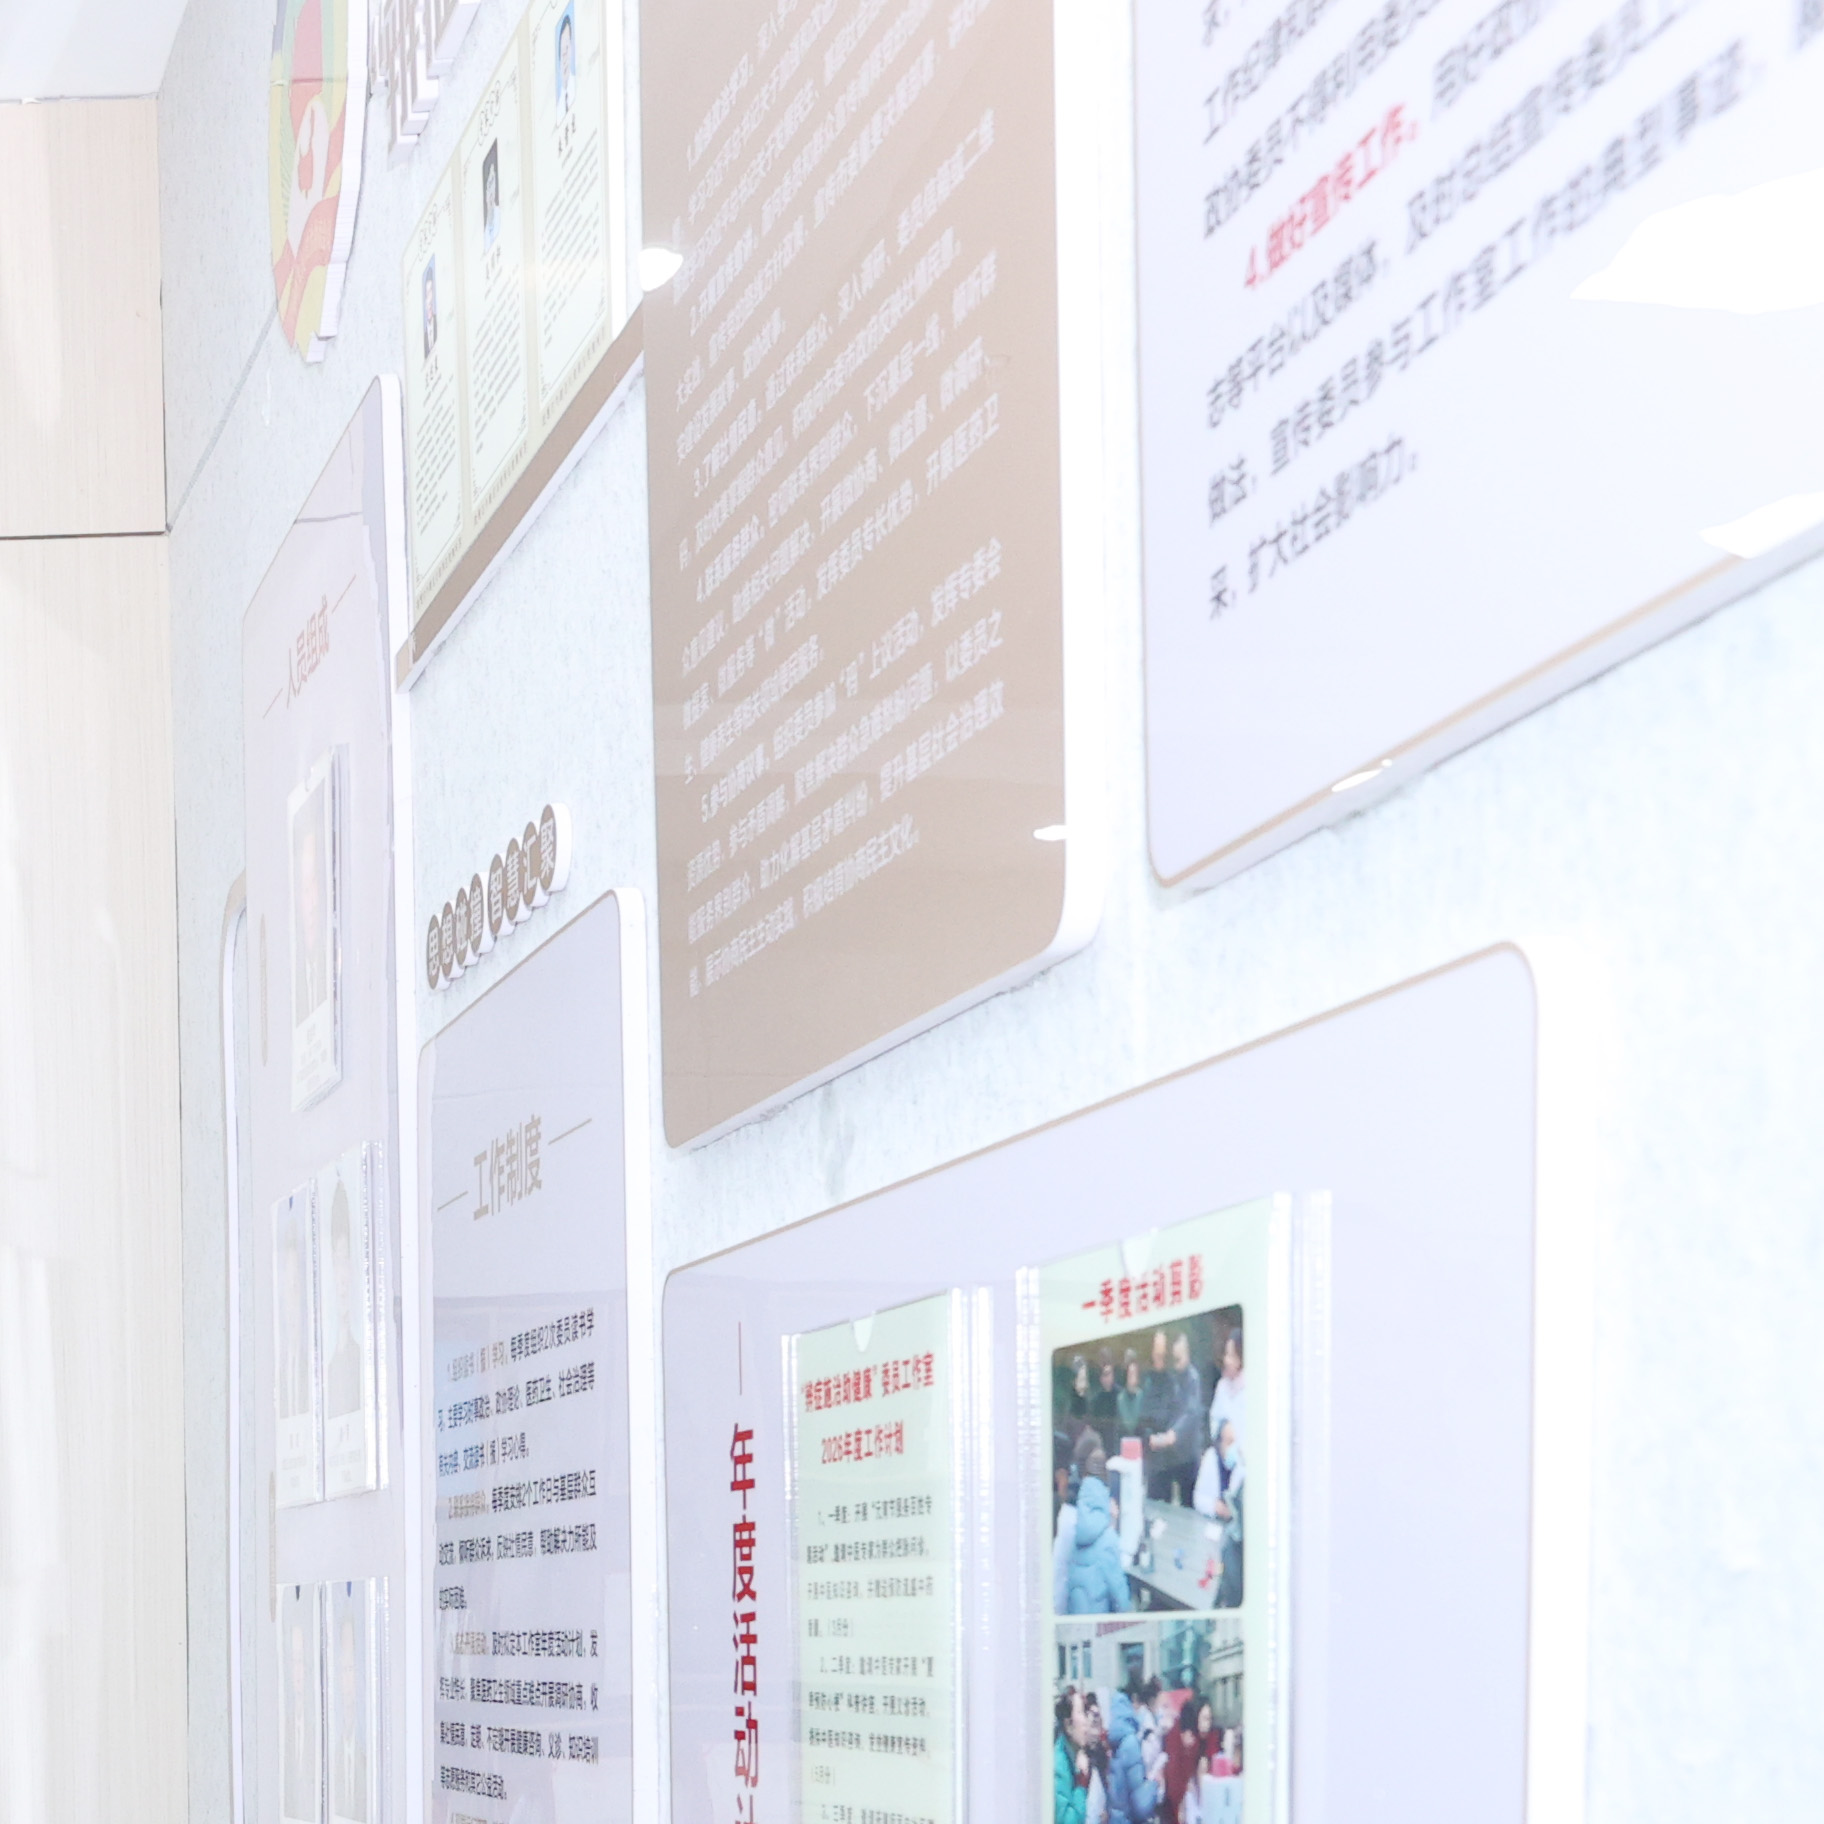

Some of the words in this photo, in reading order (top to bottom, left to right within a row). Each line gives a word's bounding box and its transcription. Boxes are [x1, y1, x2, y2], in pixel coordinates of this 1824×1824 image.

[286, 596, 330, 709] 人员组成
[490, 821, 556, 920] 智慧汇聚
[474, 1115, 541, 1220] 工作制度
[1083, 1256, 1202, 1321] 一季度活动剪影
